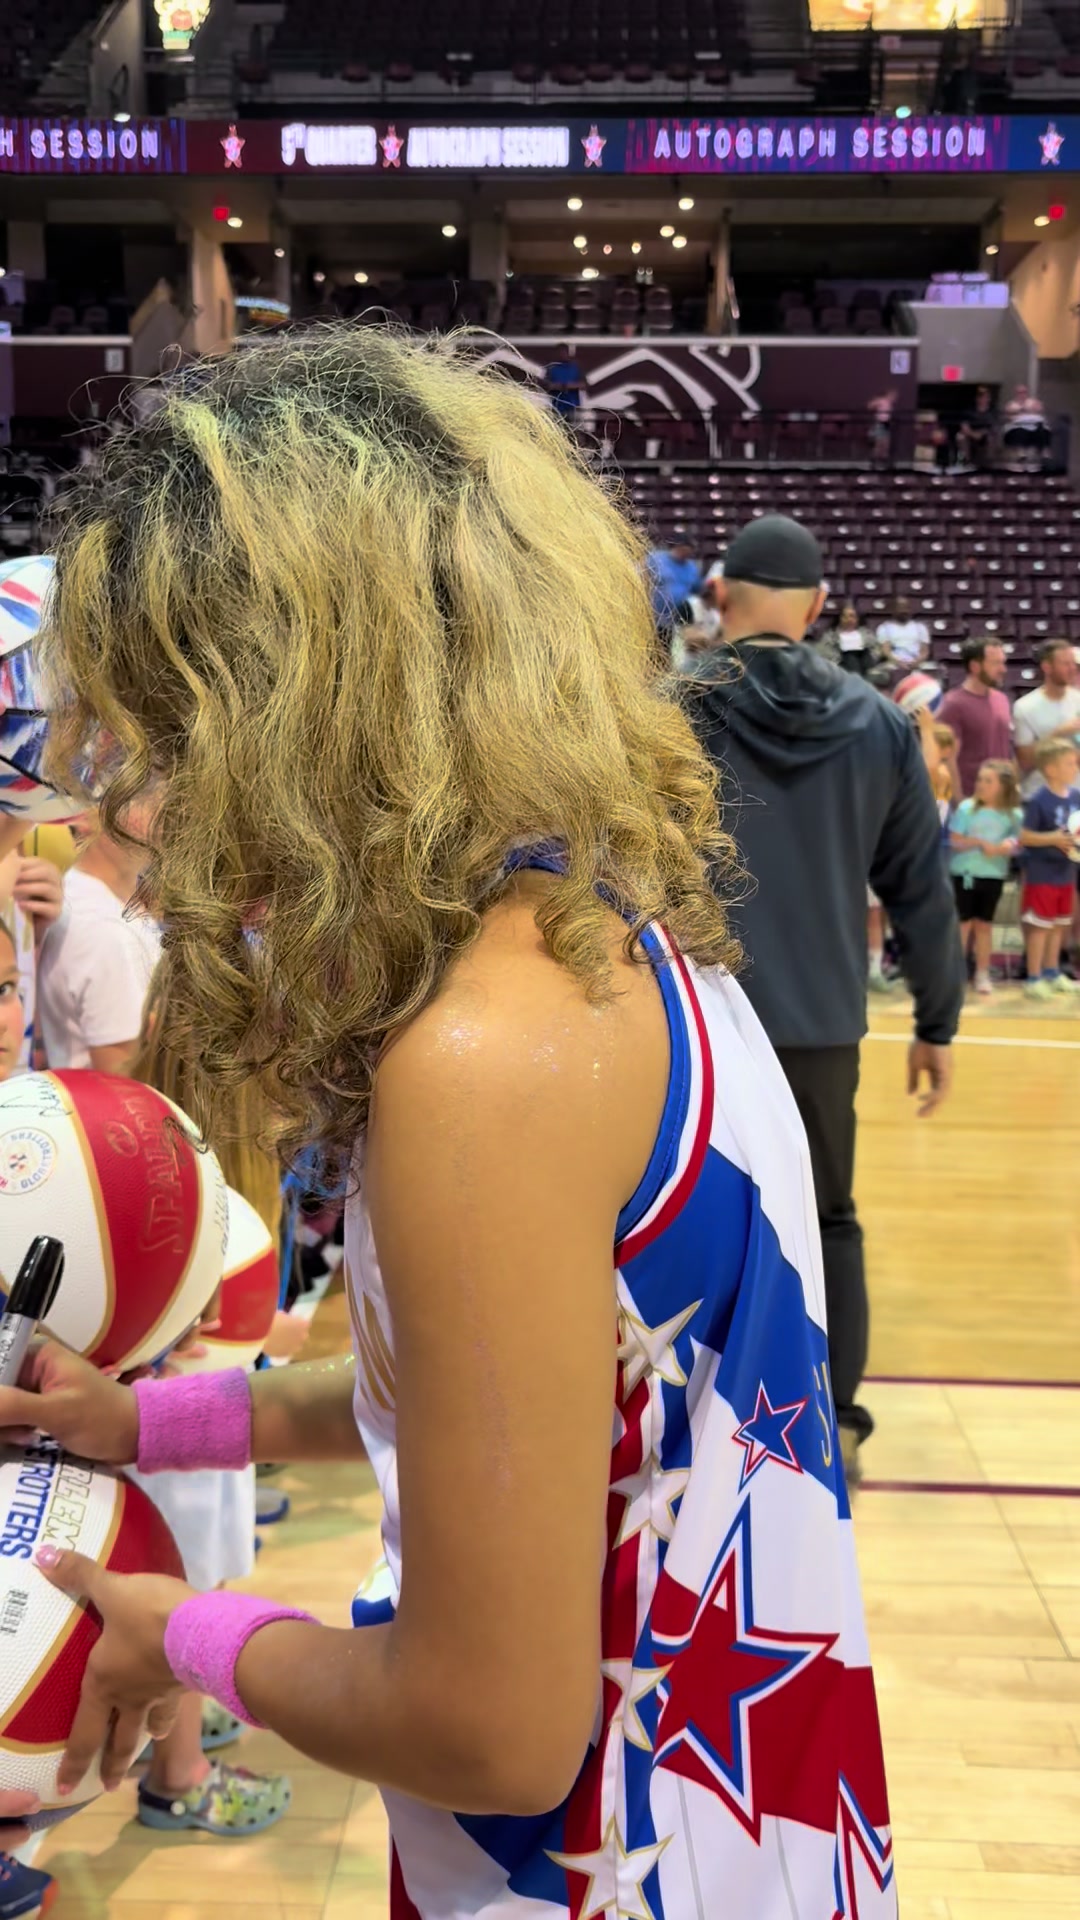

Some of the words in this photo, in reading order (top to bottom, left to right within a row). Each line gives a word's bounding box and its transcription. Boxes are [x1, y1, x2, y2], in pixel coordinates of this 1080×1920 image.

[30, 128, 158, 159] SESSION
[653, 126, 837, 159] AUTOGRAPH
[852, 126, 986, 159] SESSION
